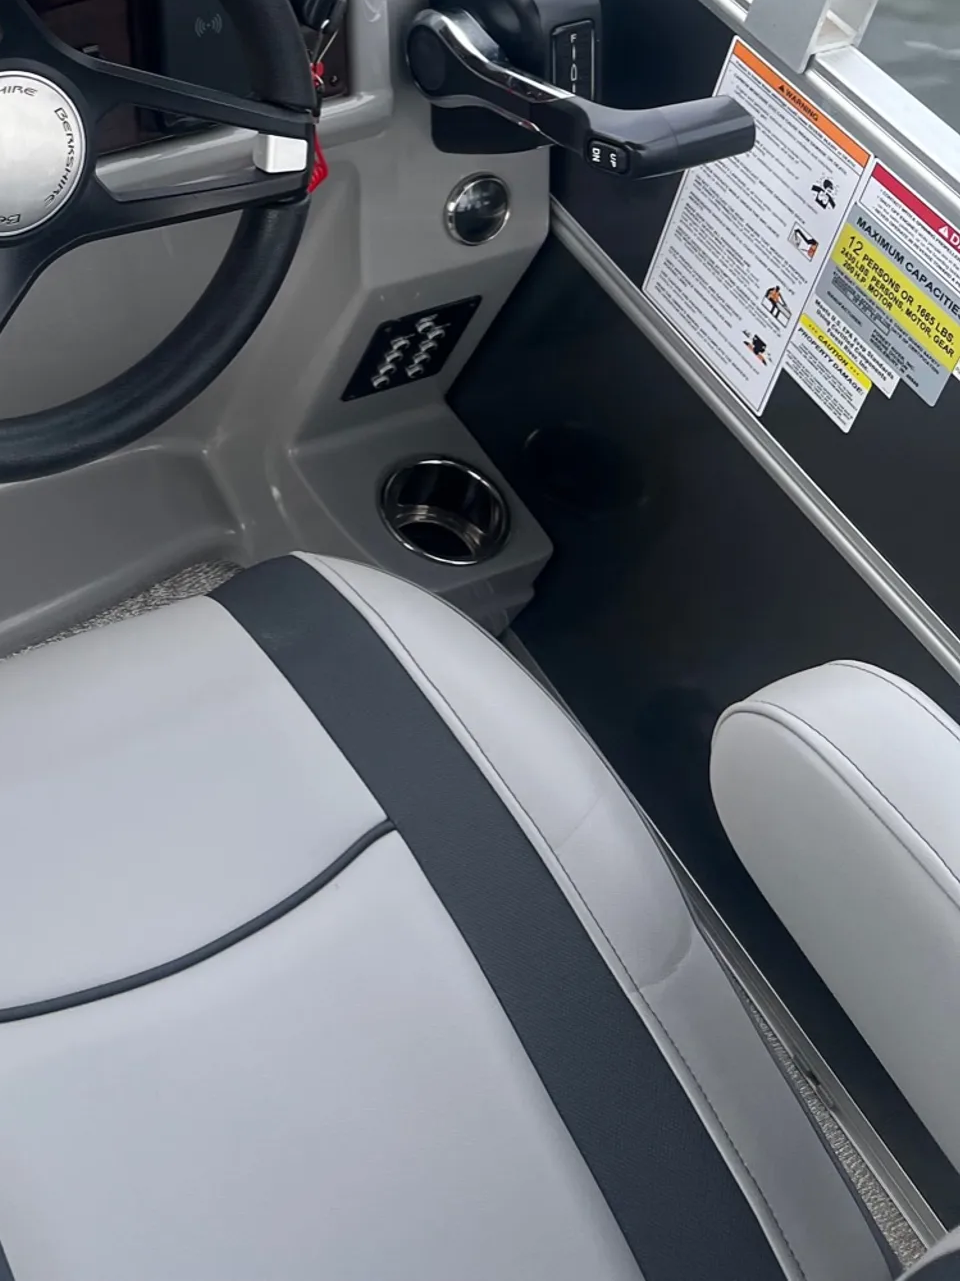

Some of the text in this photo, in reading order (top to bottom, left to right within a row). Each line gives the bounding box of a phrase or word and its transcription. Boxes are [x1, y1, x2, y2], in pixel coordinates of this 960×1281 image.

[784, 88, 819, 122] WARNING
[45, 107, 75, 207] BERKSHIRE
[592, 147, 601, 162] DN
[610, 153, 617, 168] UP
[856, 214, 904, 265] MAXIMUM
[842, 259, 854, 275] 200
[867, 282, 893, 310] MOTOR
[846, 233, 864, 257] 12
[861, 252, 900, 294] PERSONS
[899, 288, 914, 306] OR
[915, 303, 935, 326] 1665
[797, 326, 833, 364] PROPERTY
[831, 360, 864, 396] DAMAGE:
[817, 333, 848, 367] CAUTION
[932, 333, 954, 358] GEAR
